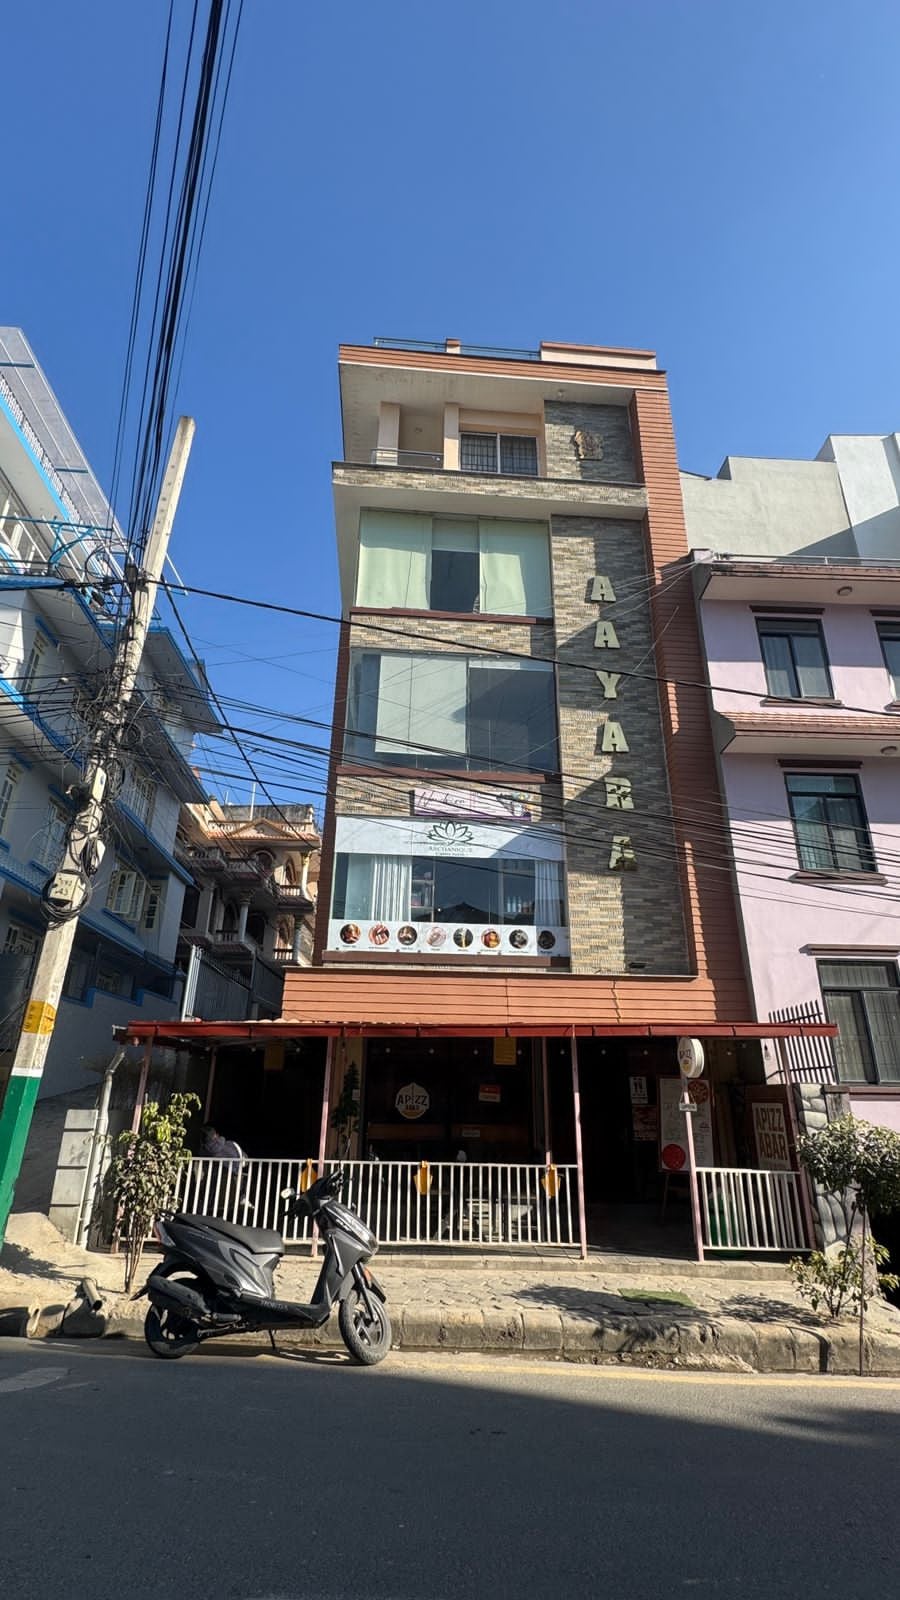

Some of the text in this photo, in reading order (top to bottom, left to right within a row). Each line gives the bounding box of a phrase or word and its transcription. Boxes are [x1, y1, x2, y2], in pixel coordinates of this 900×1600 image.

[397, 1095, 428, 1106] APIZZ
[755, 1106, 785, 1132] APIZZ
[758, 1132, 788, 1161] ABAR
